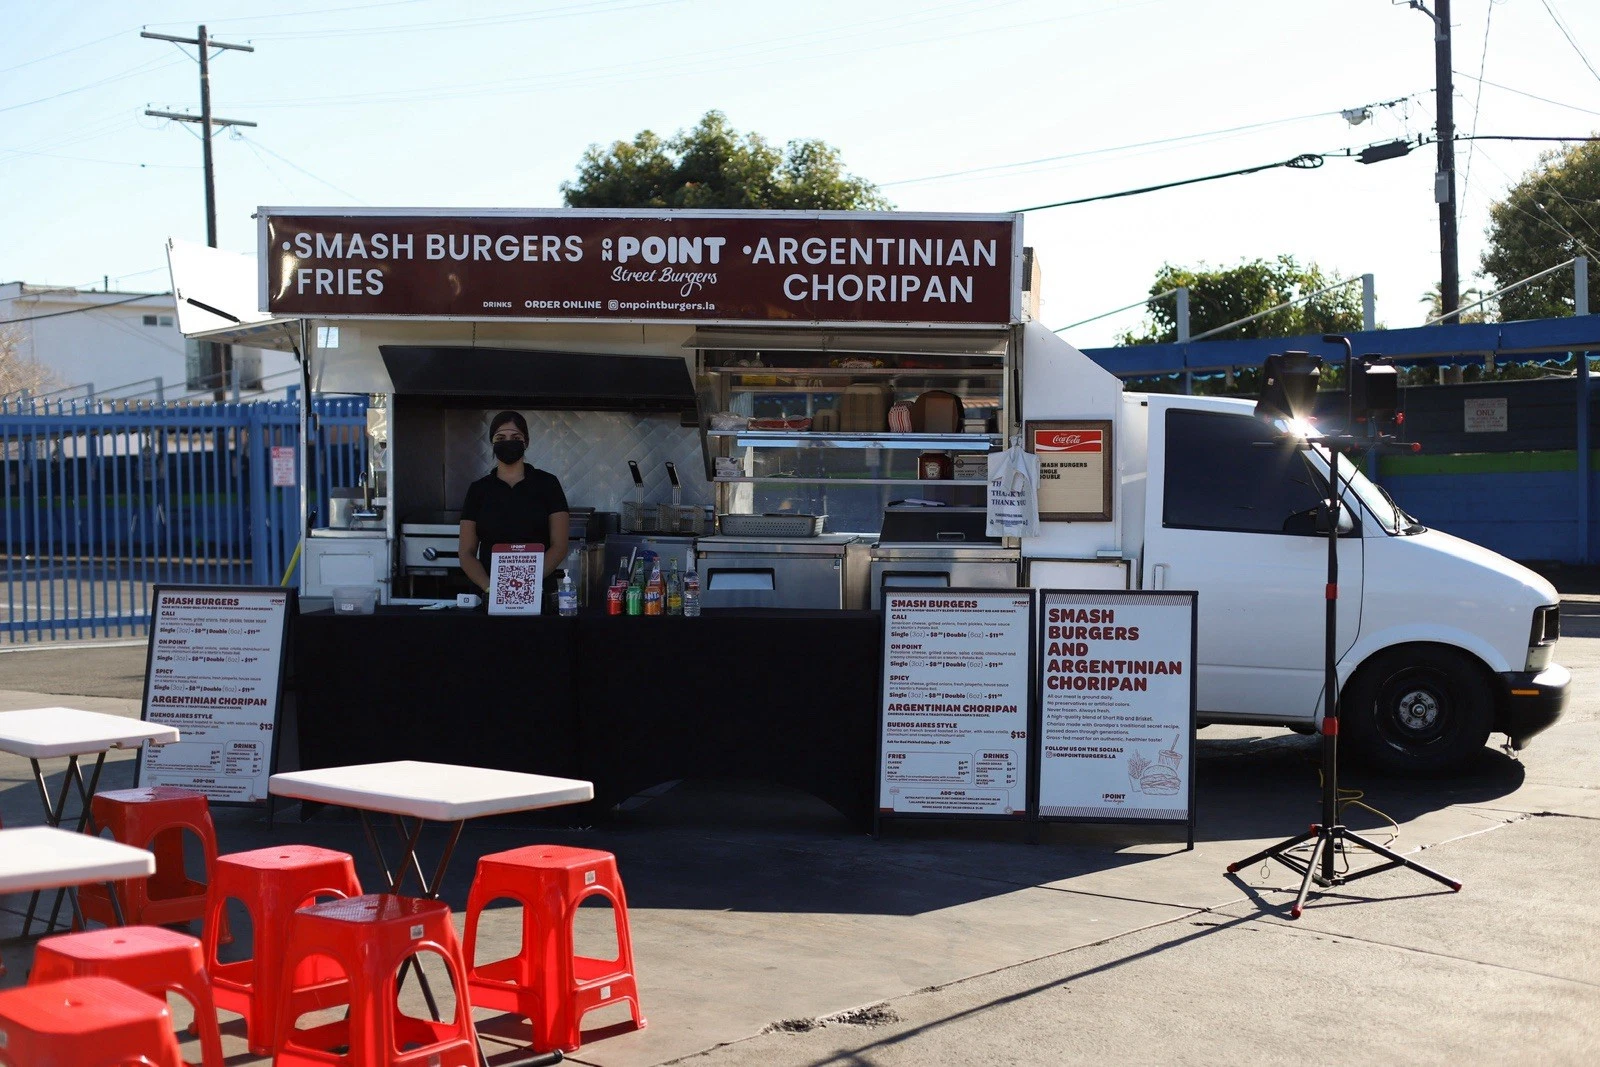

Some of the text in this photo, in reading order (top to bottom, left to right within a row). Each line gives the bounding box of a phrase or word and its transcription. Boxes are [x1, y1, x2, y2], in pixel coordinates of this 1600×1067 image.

[294, 232, 584, 262] SMASH BURGERS
[618, 236, 726, 264] POINT
[752, 237, 997, 267] ARGENTINIAN
[297, 268, 385, 296] FRIES
[610, 266, 717, 298] Street Burgers
[783, 273, 973, 304] CHORIPAN
[524, 300, 562, 309] ORDER
[563, 300, 602, 309] ONLINE
[1049, 609, 1114, 623] SMASH
[1049, 626, 1139, 640] BURGERS
[1048, 642, 1088, 656] AND
[1047, 660, 1182, 674] ARGENTINIAN
[1047, 676, 1147, 691] CHORIPAN
[152, 696, 217, 704] ARGENTINIAN
[888, 704, 961, 712] ARGENTINIAN
[1011, 731, 1026, 739] $13
